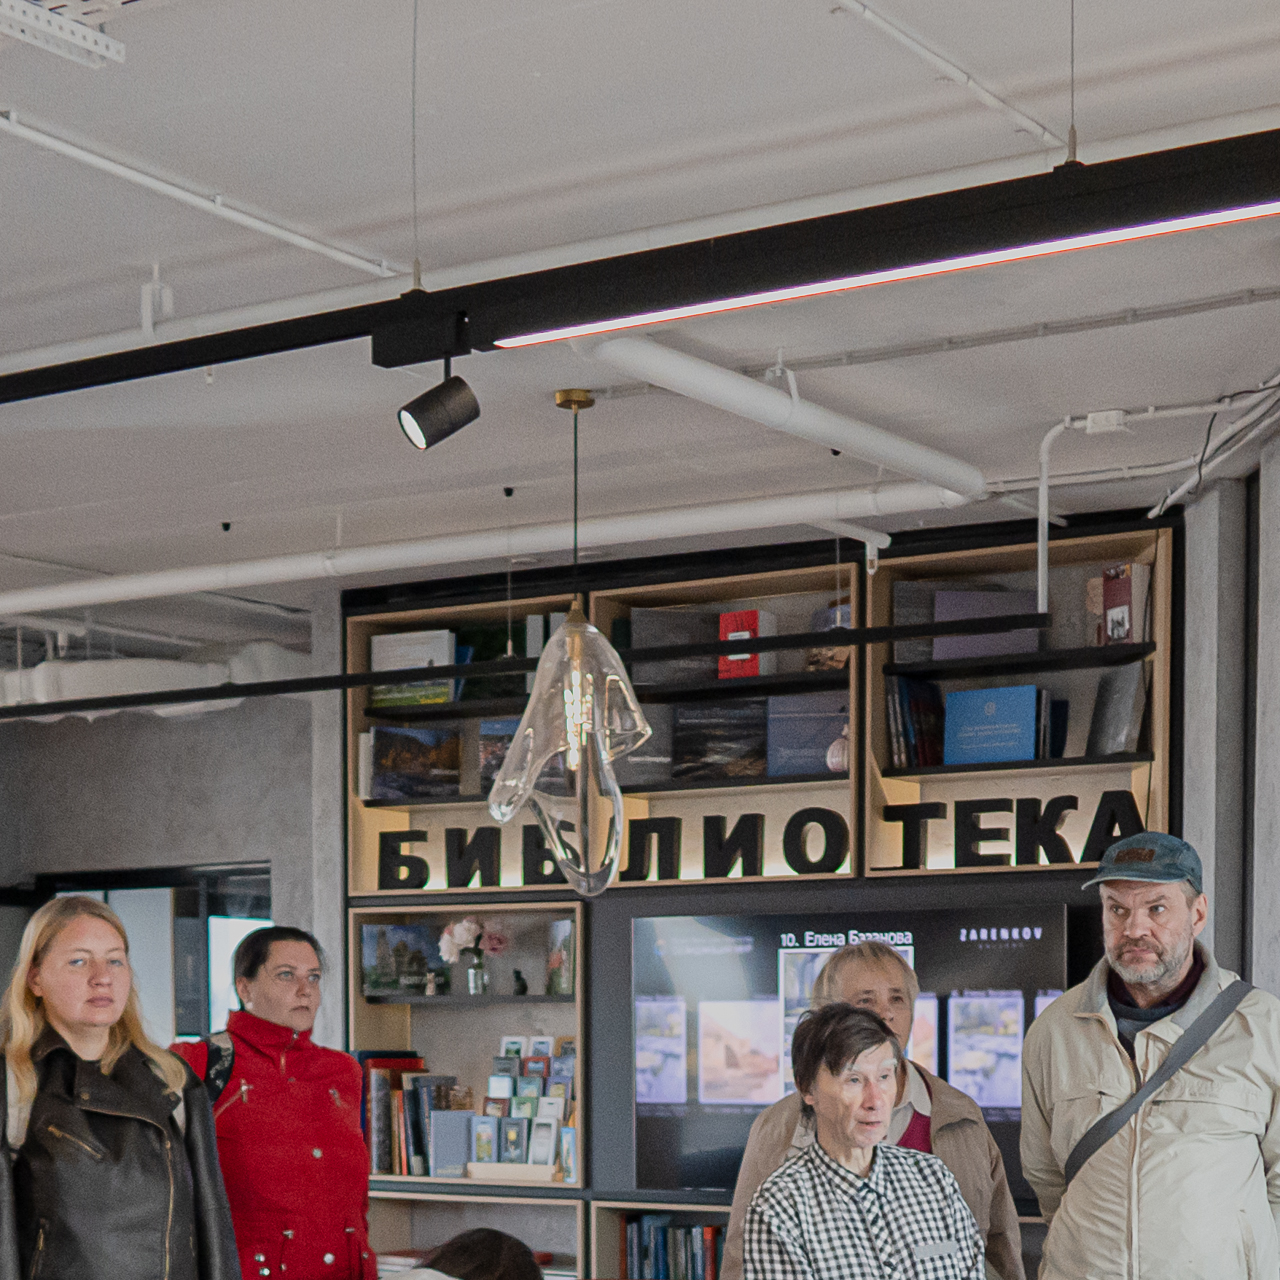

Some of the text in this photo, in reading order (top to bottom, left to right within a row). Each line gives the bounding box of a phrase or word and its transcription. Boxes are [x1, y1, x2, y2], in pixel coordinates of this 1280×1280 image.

[378, 789, 1147, 891] БИБЛИОТЕКА
[780, 932, 800, 947] 10.
[804, 930, 846, 947] Елена
